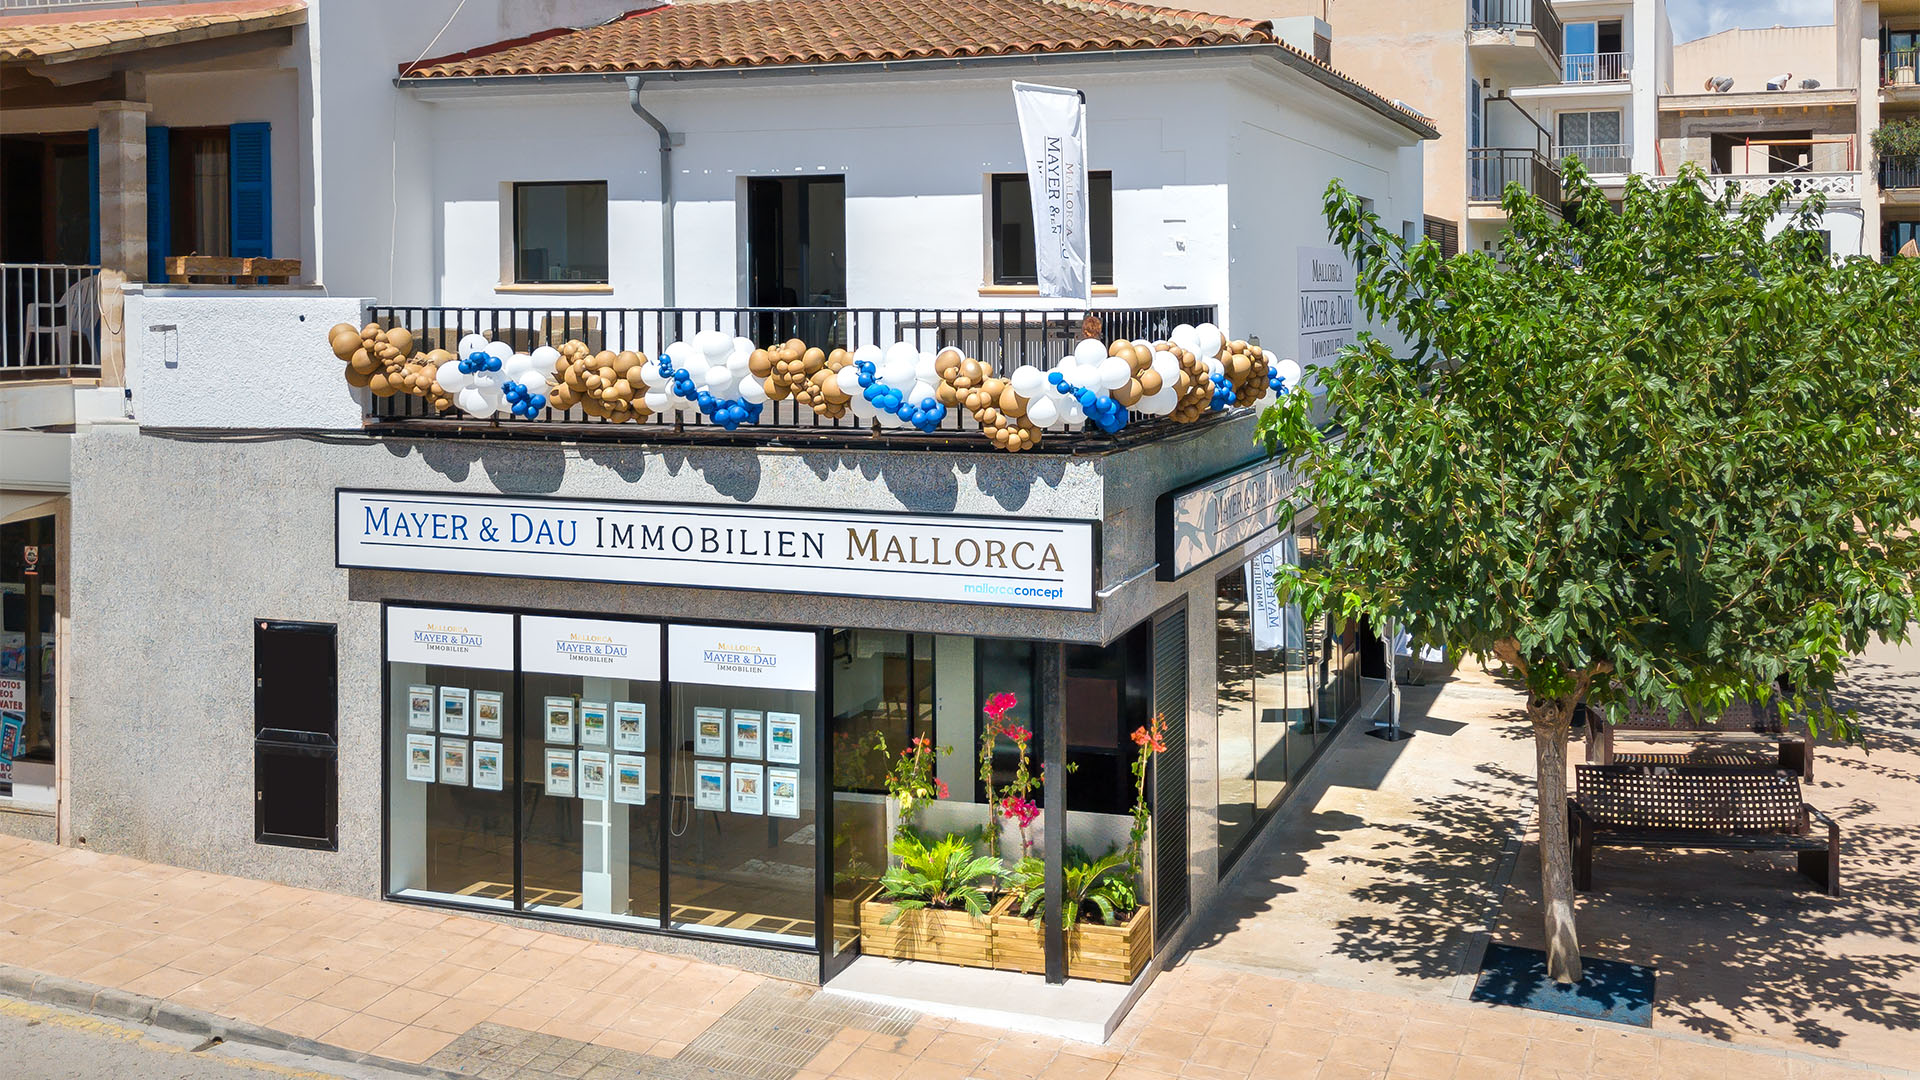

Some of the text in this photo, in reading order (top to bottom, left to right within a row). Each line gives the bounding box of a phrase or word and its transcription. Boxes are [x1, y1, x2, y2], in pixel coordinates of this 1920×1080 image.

[1047, 136, 1061, 200] MAYER
[1065, 162, 1074, 237] MALLORCA
[1312, 259, 1343, 282] MALLORCA
[1300, 295, 1352, 329] MAYER & DAU
[364, 506, 1065, 572] MAYER & DAU IMMOBILIEN MALLORCA
[964, 582, 1064, 600] mallorcaconcept
[427, 623, 468, 633] MALLORCA
[414, 631, 483, 646] MAYER & DAU
[570, 633, 613, 643] MALLORCA
[426, 644, 469, 653] IMMOBILIEN
[556, 642, 628, 656] MAYER & DAU
[718, 642, 761, 652] MALLORCA
[569, 654, 614, 663] IMMOBILIEN
[703, 651, 777, 666] MAYER & DAU
[717, 664, 762, 673] IMMOBILIEN
[0, 681, 21, 689] OTOS
